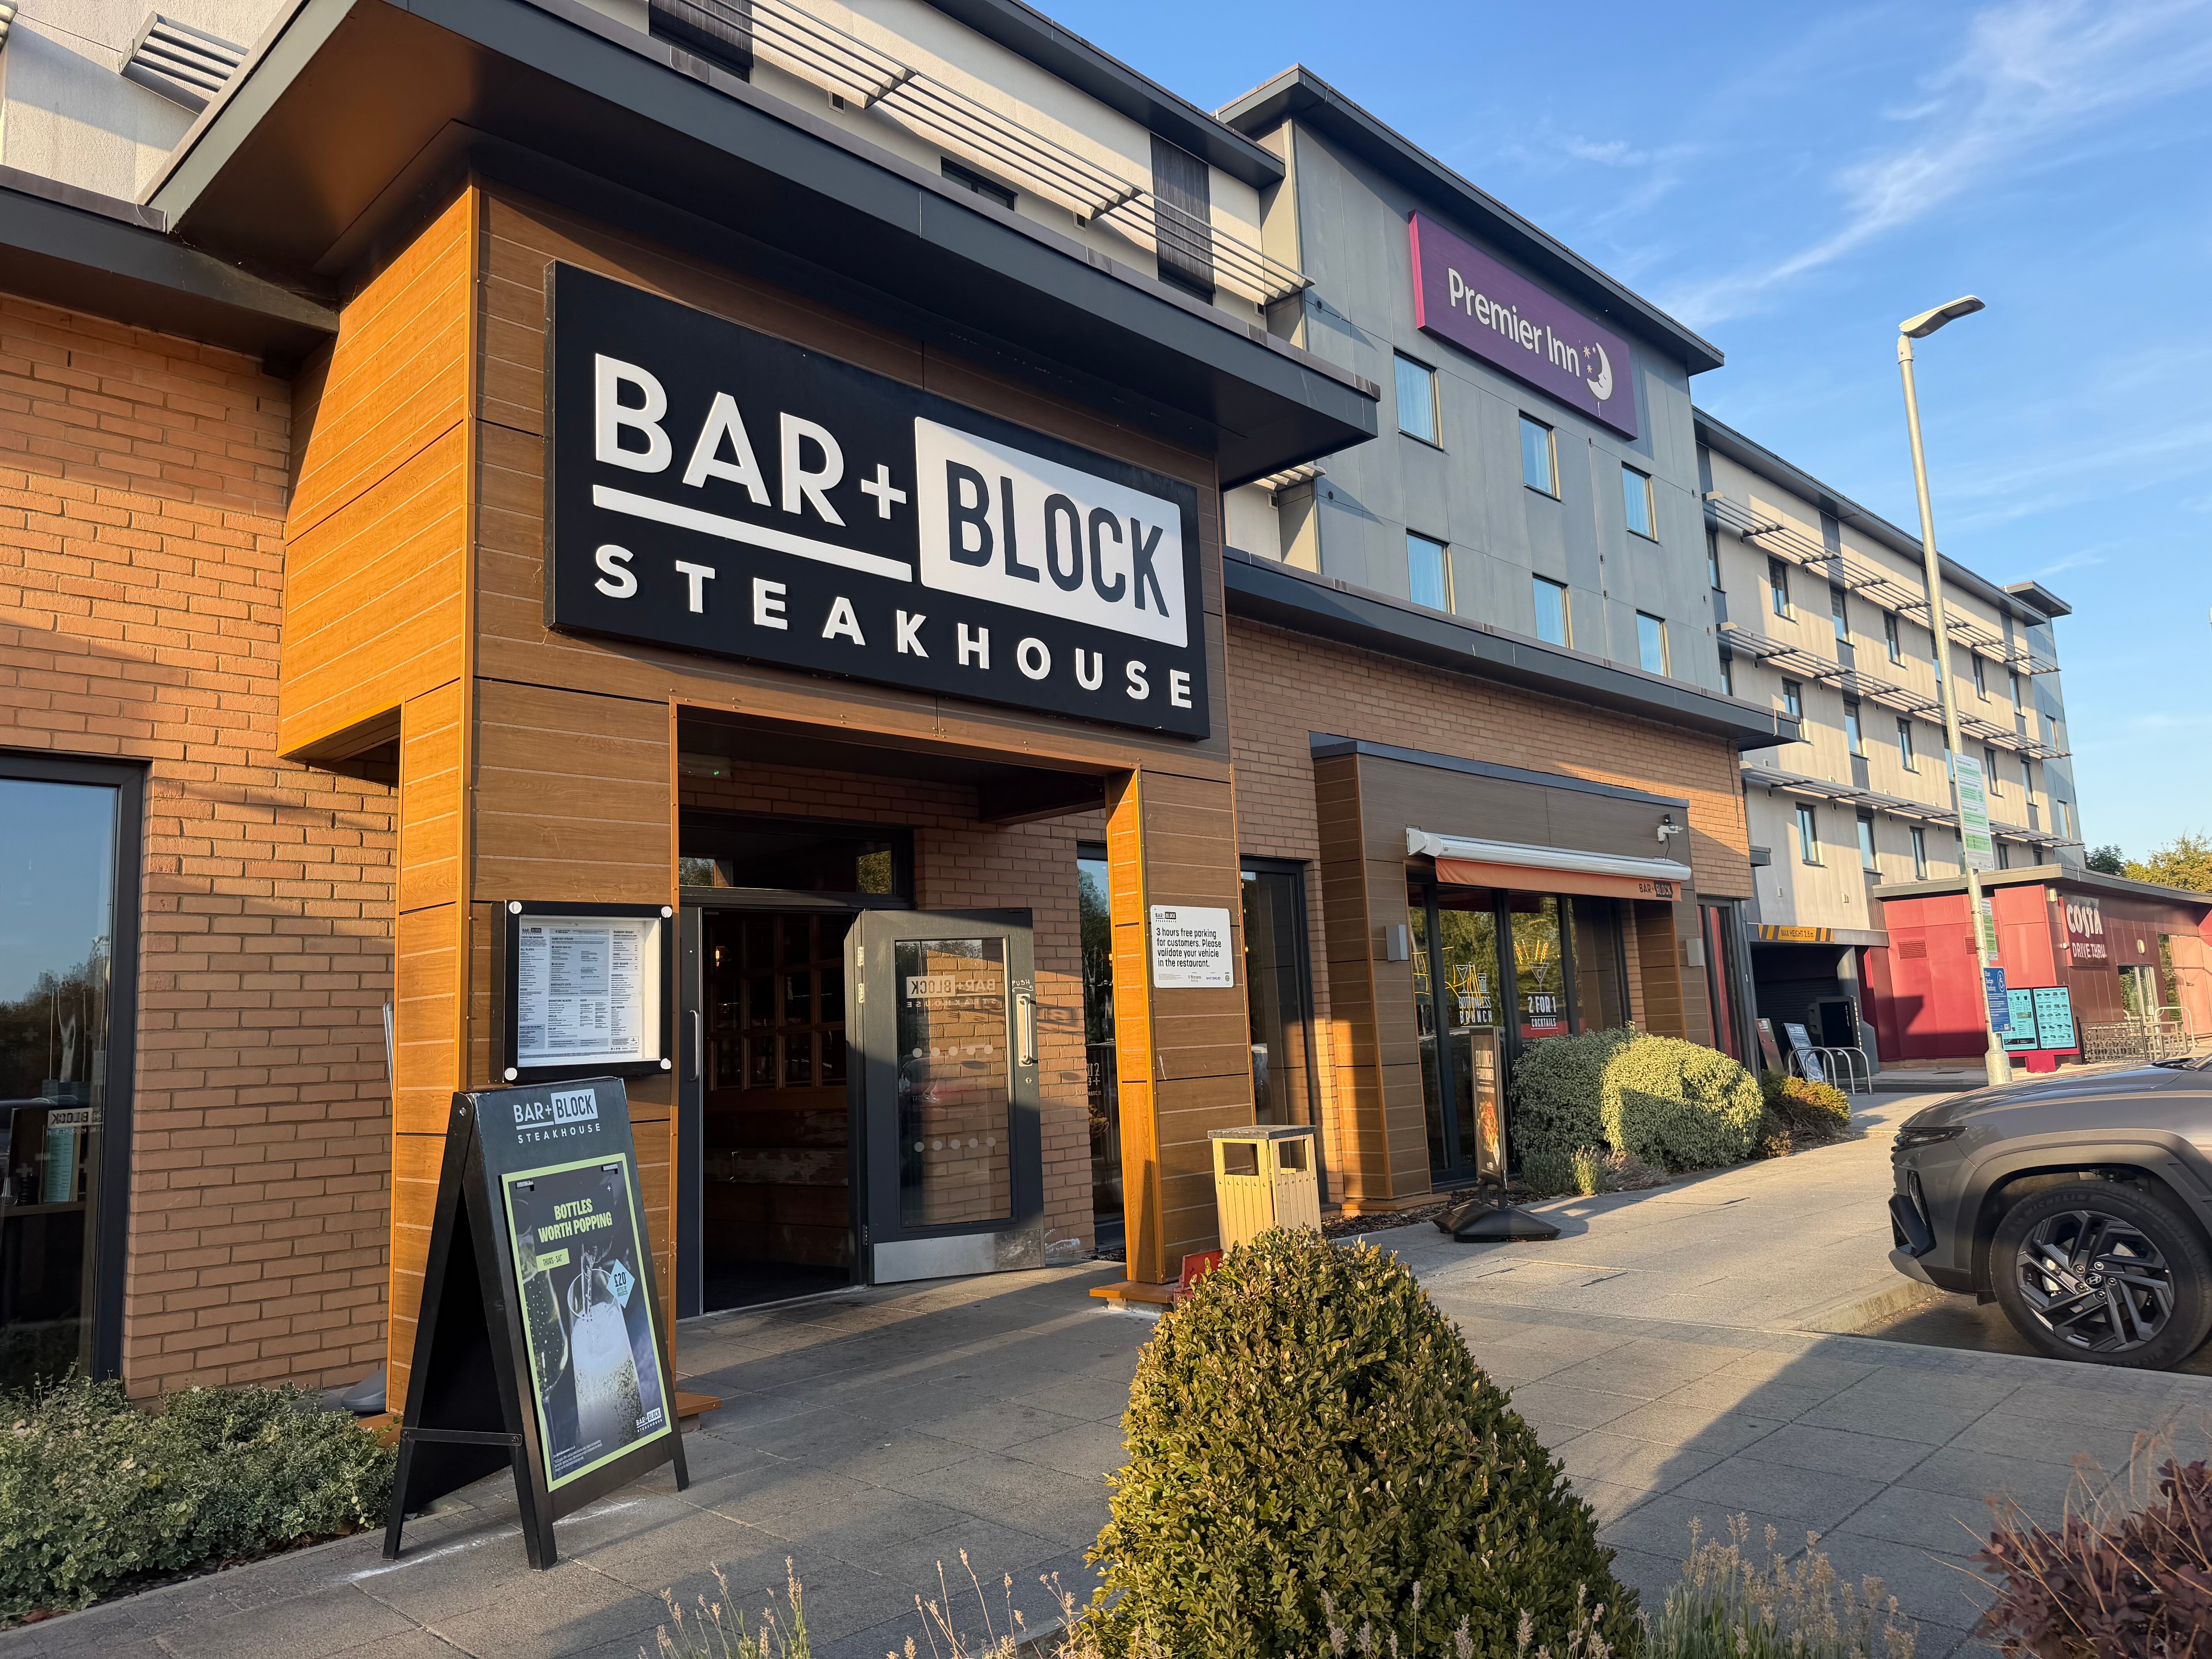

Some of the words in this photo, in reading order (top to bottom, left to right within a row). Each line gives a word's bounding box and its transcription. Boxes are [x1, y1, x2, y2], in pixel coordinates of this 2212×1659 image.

[1448, 268, 1542, 354] Premier
[1546, 325, 1580, 377] Inn
[946, 459, 1170, 618] BLOCK
[594, 544, 1193, 709] STEAKHOUSE
[1655, 884, 1672, 895] BLOCK
[2066, 904, 2103, 938] COSTA
[1156, 927, 1161, 936] 3
[1163, 927, 1179, 936] hours
[1181, 928, 1193, 937] free
[1195, 929, 1216, 939] parking
[1157, 938, 1166, 946] for
[1168, 939, 1200, 947] customers.
[1202, 939, 1221, 948] Please
[2072, 942, 2092, 959] DRIVE
[2090, 943, 2106, 959] THRU
[1158, 948, 1182, 957] validate
[1184, 950, 1197, 959] your
[1199, 949, 1219, 958] vehicle
[1158, 958, 1164, 967] in
[1165, 958, 1175, 967] the
[1458, 996, 1492, 1009] BOTTOMLESS
[1528, 996, 1534, 1013] 2
[1535, 996, 1550, 1013] FOR
[1552, 996, 1556, 1013] 1
[1460, 1010, 1493, 1024] BRUNCH
[1531, 1018, 1557, 1027] COCKTAILS
[555, 1094, 594, 1118] BLOCK
[517, 1123, 601, 1144] STEAKHOUSE
[553, 1198, 593, 1221] BOTTLES
[538, 1220, 573, 1243] WORTH
[574, 1211, 613, 1235] POPPING
[648, 1410, 660, 1421] BLOCK
